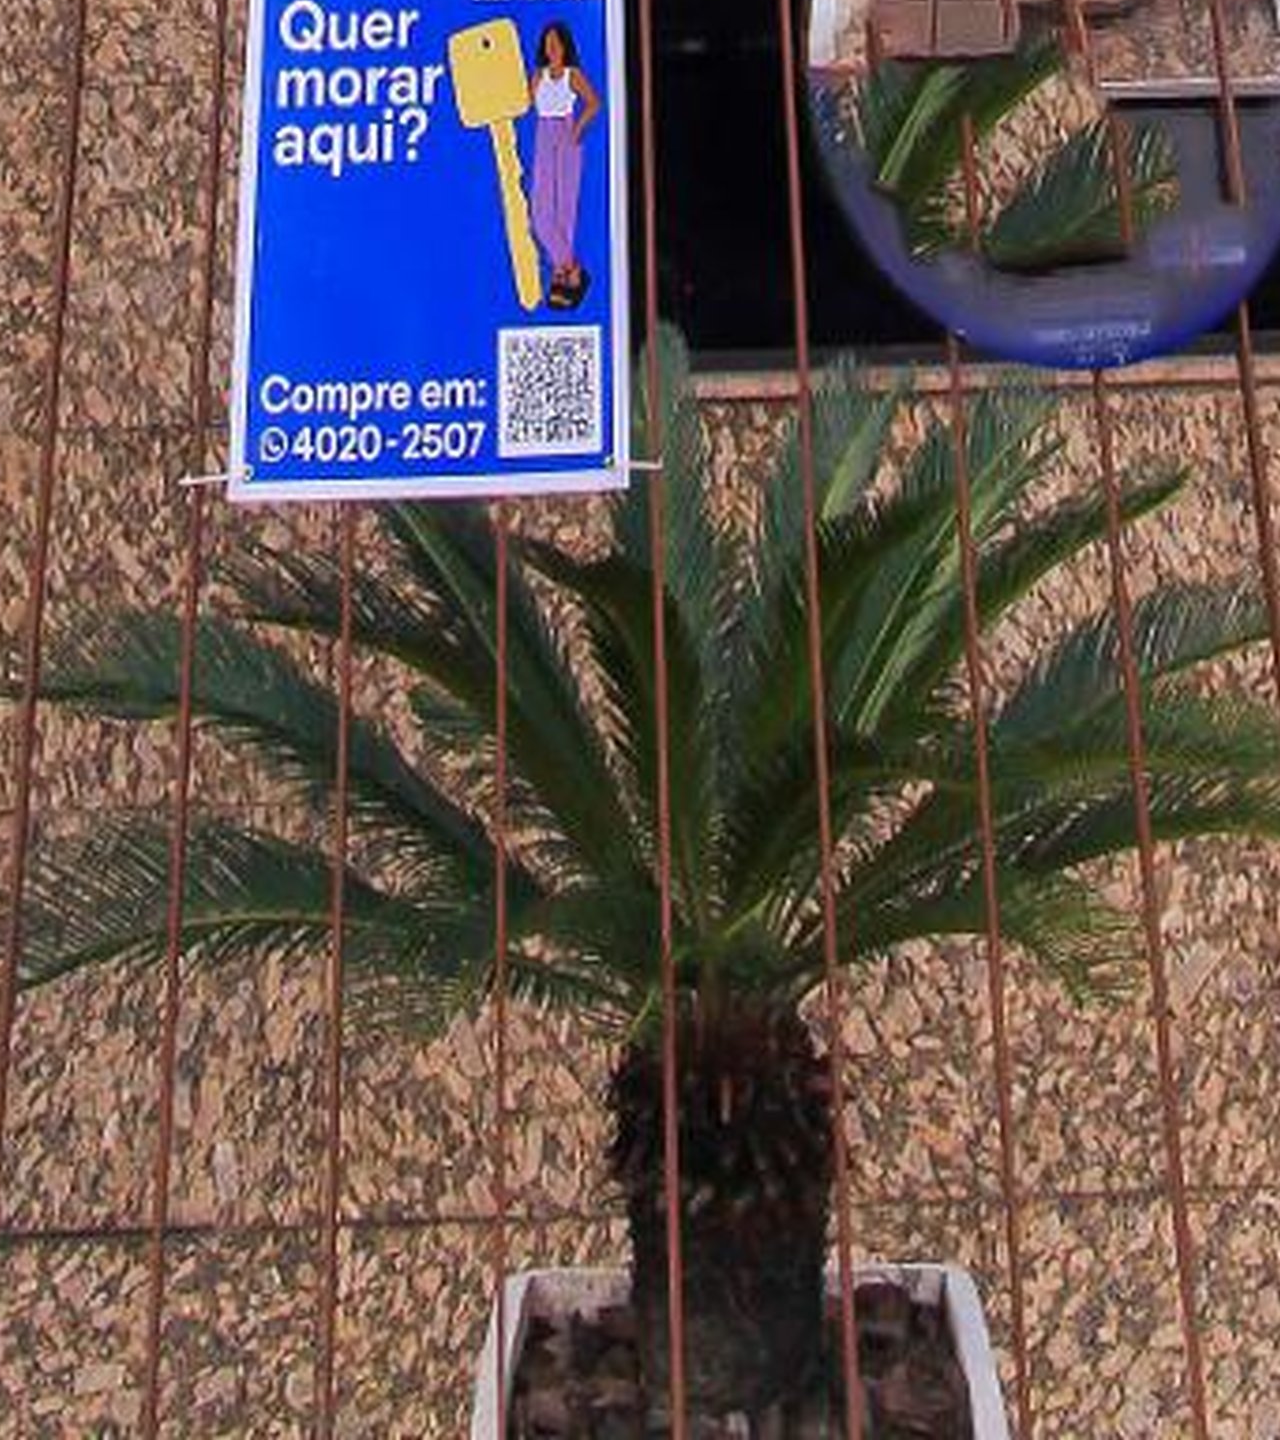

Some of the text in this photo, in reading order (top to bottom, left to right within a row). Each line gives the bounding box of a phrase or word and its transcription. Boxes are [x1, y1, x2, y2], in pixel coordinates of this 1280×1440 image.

[279, 0, 420, 52] Quer
[276, 63, 444, 108] morar
[273, 111, 428, 175] aqui?
[261, 374, 487, 420] Compre em:
[292, 423, 487, 461] 4020-2507
